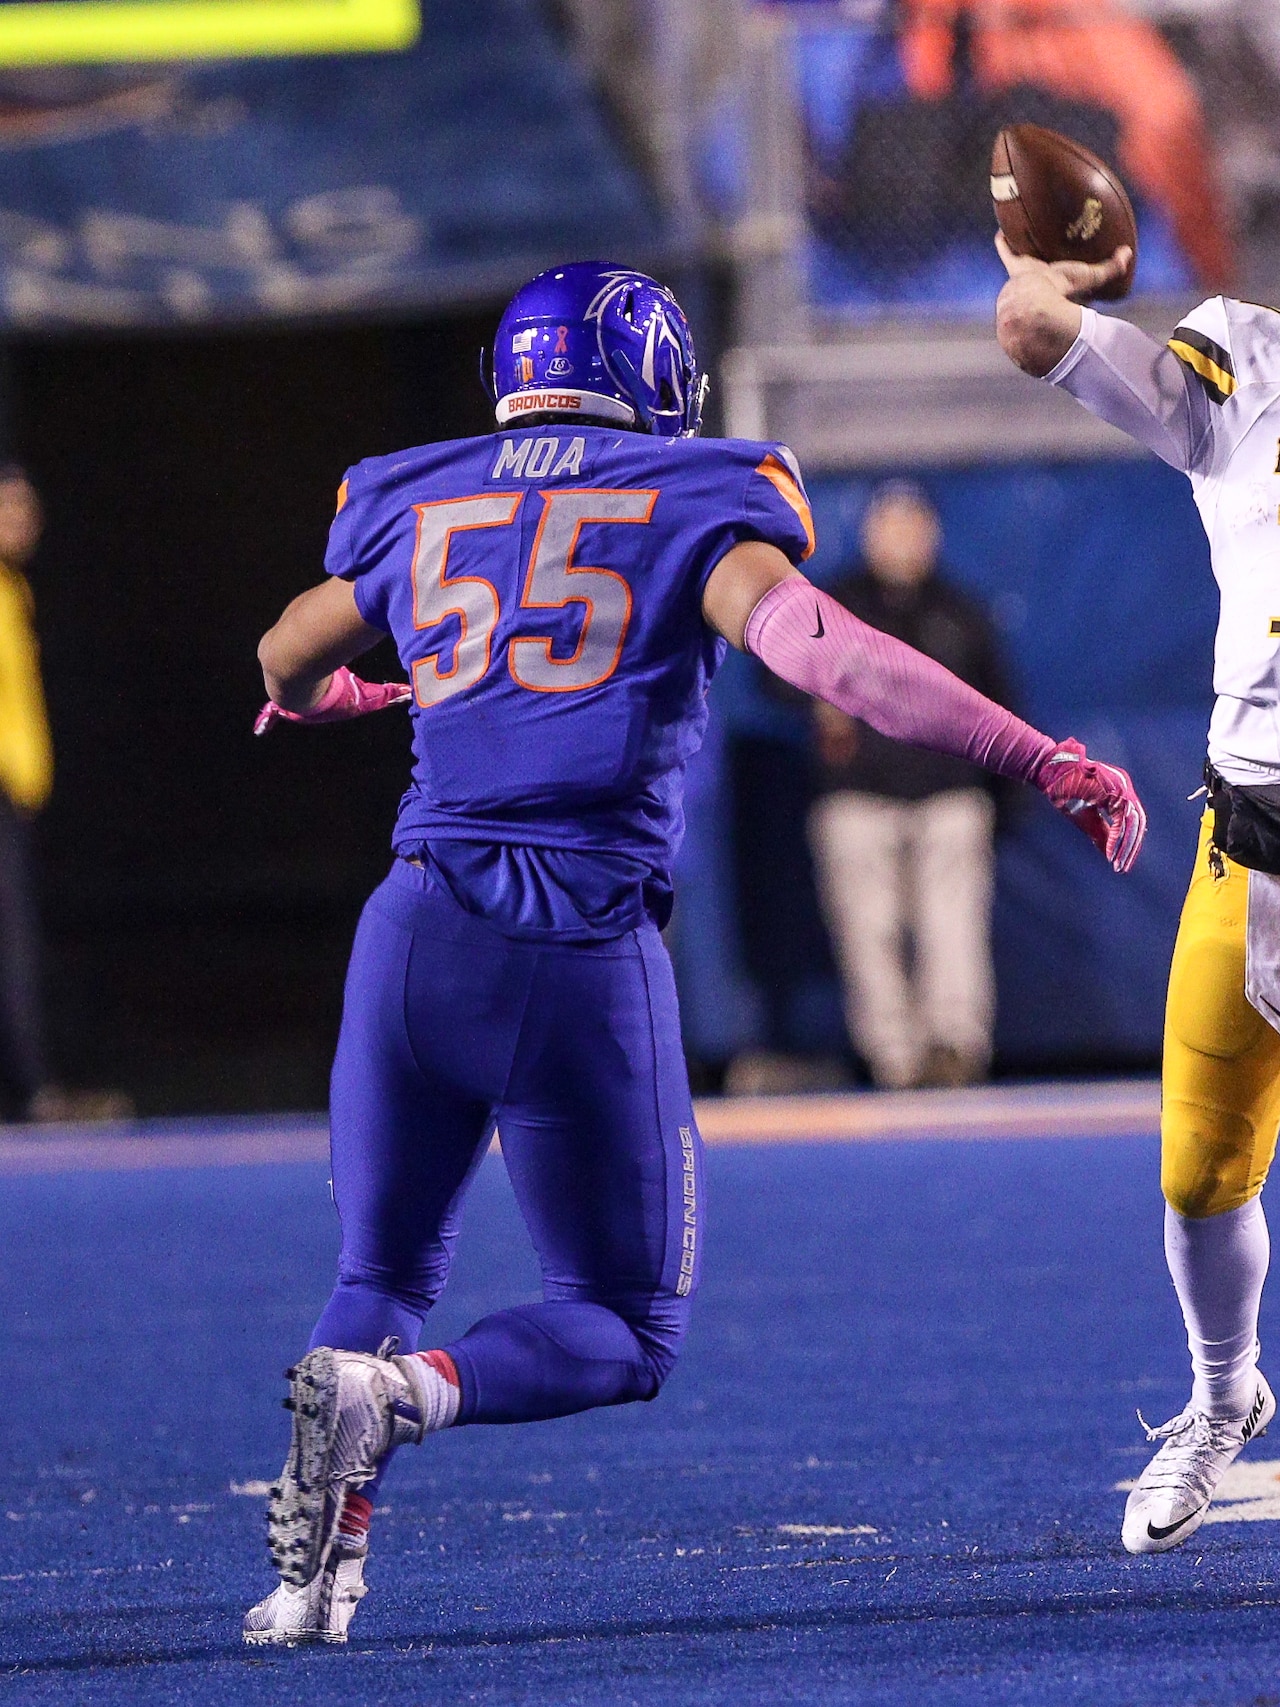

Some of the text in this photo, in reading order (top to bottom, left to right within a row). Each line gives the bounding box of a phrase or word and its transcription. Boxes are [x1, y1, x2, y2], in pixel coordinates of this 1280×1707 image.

[508, 394, 582, 413] BRONCOS
[492, 437, 586, 479] MOA
[412, 489, 659, 708] 55
[677, 1126, 696, 1297] BRONCOS
[1241, 1383, 1265, 1444] NIKE
